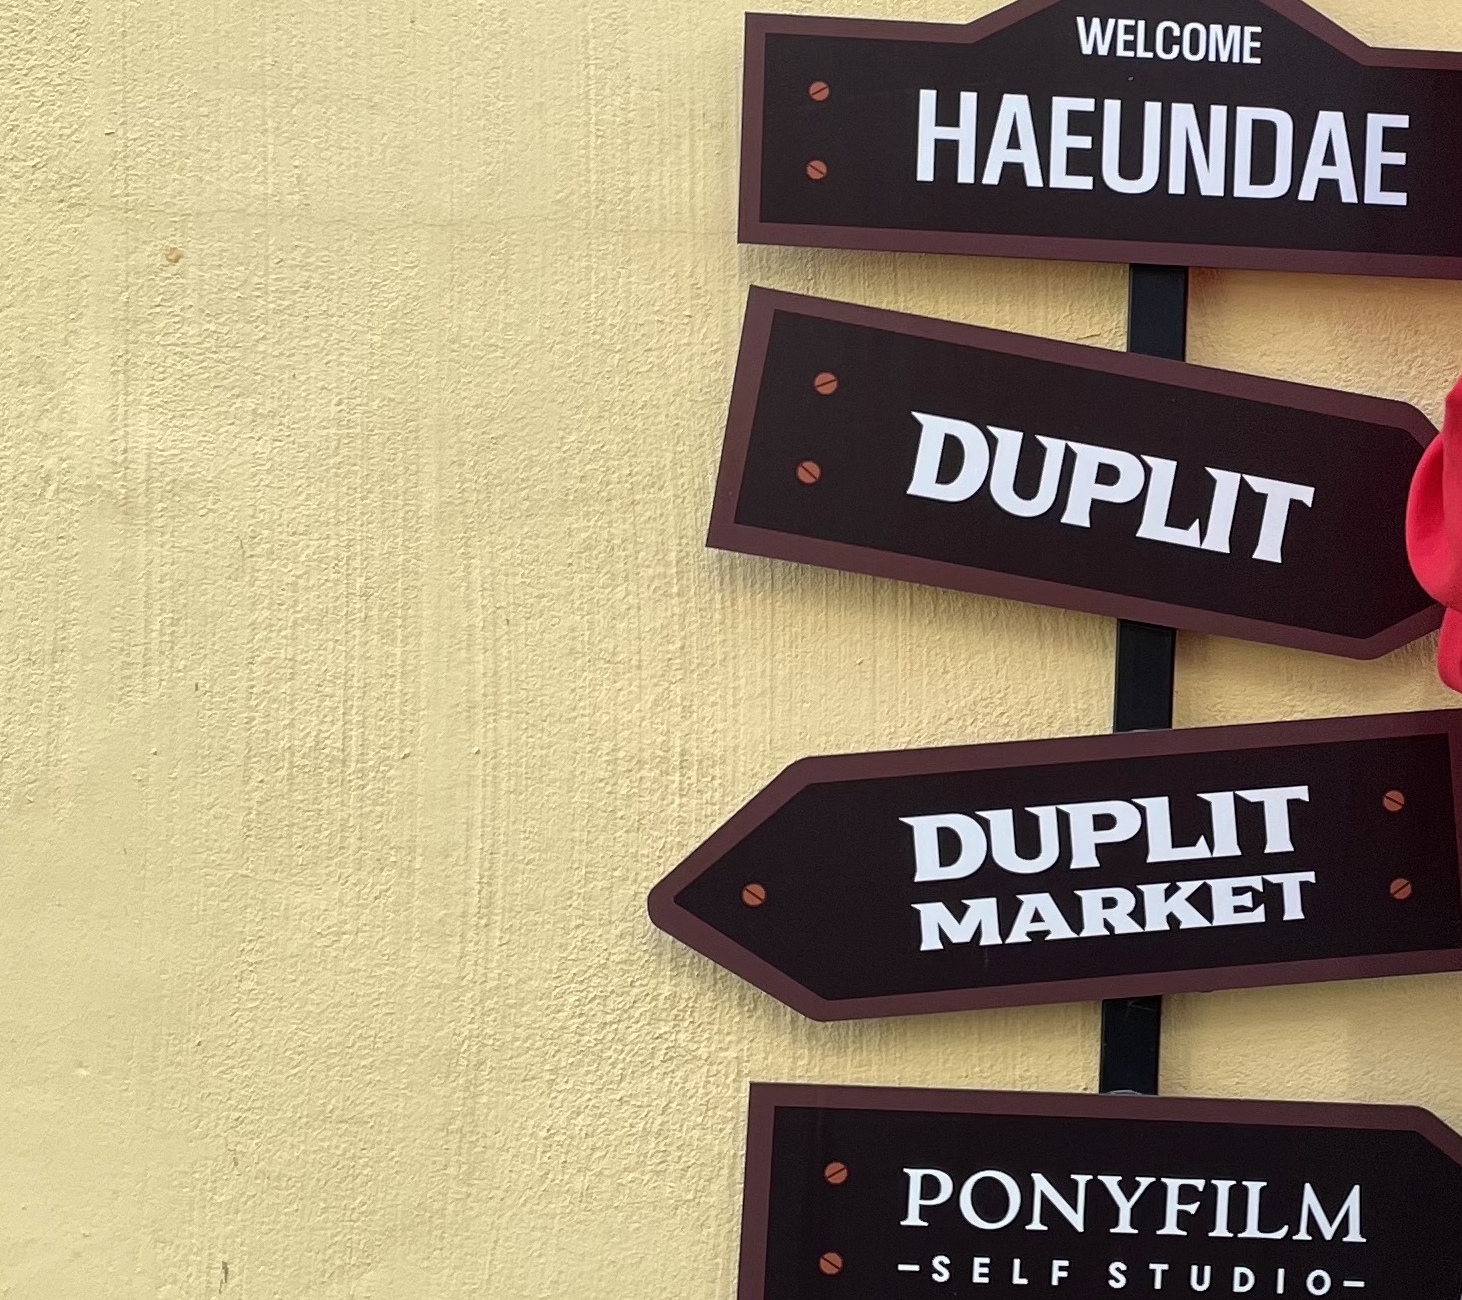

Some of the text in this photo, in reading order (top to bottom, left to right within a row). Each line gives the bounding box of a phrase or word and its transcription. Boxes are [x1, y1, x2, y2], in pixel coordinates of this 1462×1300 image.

[1076, 16, 1262, 65] WELCOME
[916, 89, 1410, 206] HAEUNDAE
[906, 411, 1315, 564] DUPLIT
[899, 785, 1310, 882] DUPLIT
[911, 870, 1316, 951] MARKET
[900, 1167, 1367, 1244] PONYFILM
